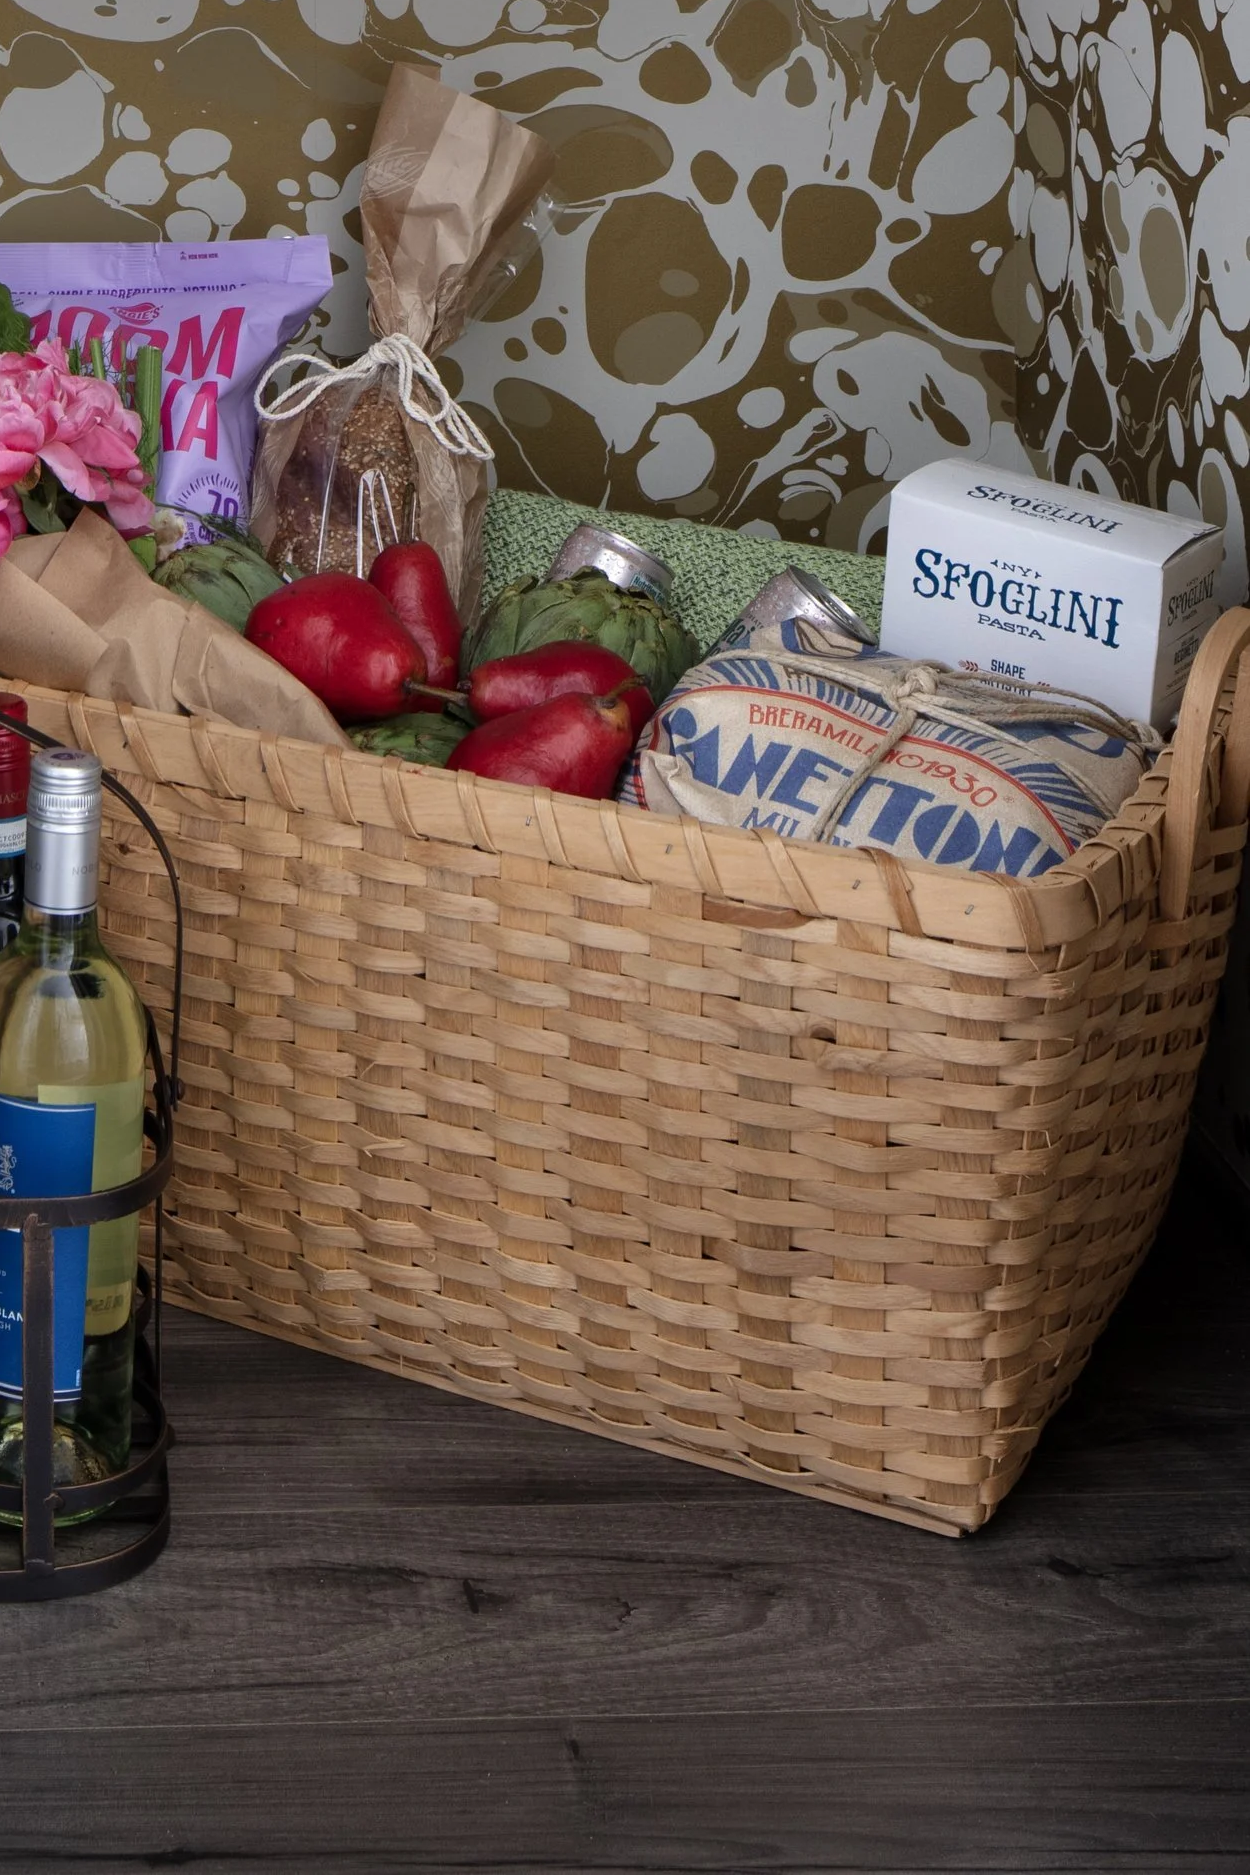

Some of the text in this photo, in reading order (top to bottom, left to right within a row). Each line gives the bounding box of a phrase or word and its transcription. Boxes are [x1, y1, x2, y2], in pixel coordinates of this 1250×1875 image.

[967, 485, 1124, 535] SFOGLINI
[912, 548, 1124, 649] SFOGLINI
[1167, 569, 1215, 627] SFOGLINI
[977, 613, 1047, 642] PASTA
[990, 658, 1026, 680] SHAPE
[661, 706, 1065, 878] PANETTON
